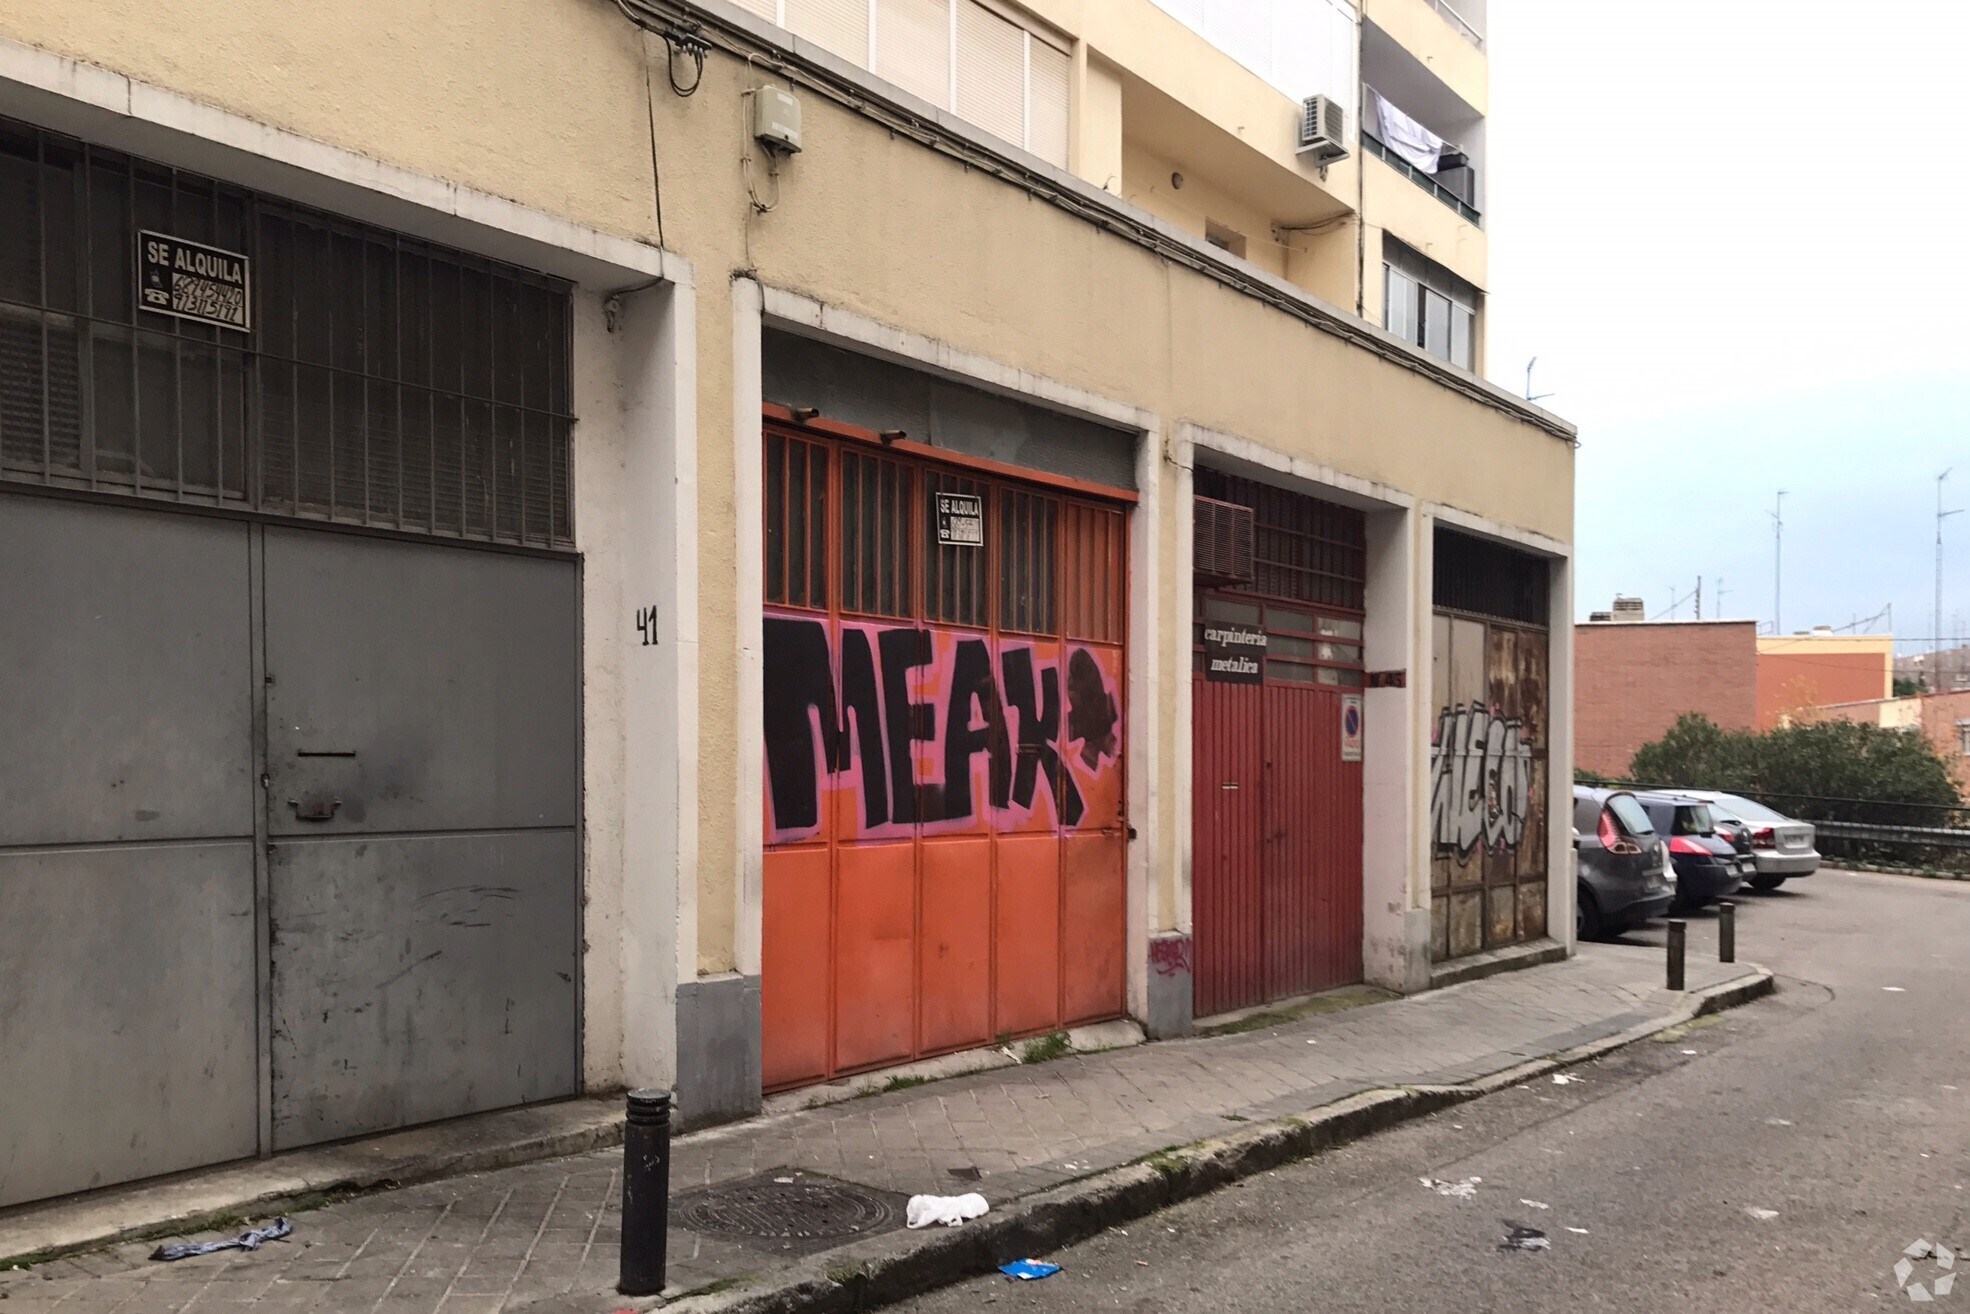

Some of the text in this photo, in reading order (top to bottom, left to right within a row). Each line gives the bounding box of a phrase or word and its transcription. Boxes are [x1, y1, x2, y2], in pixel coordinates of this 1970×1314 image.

[147, 241, 243, 285] SE ALQUILA
[940, 499, 979, 516] SE ALQUILA
[636, 604, 659, 647] 41
